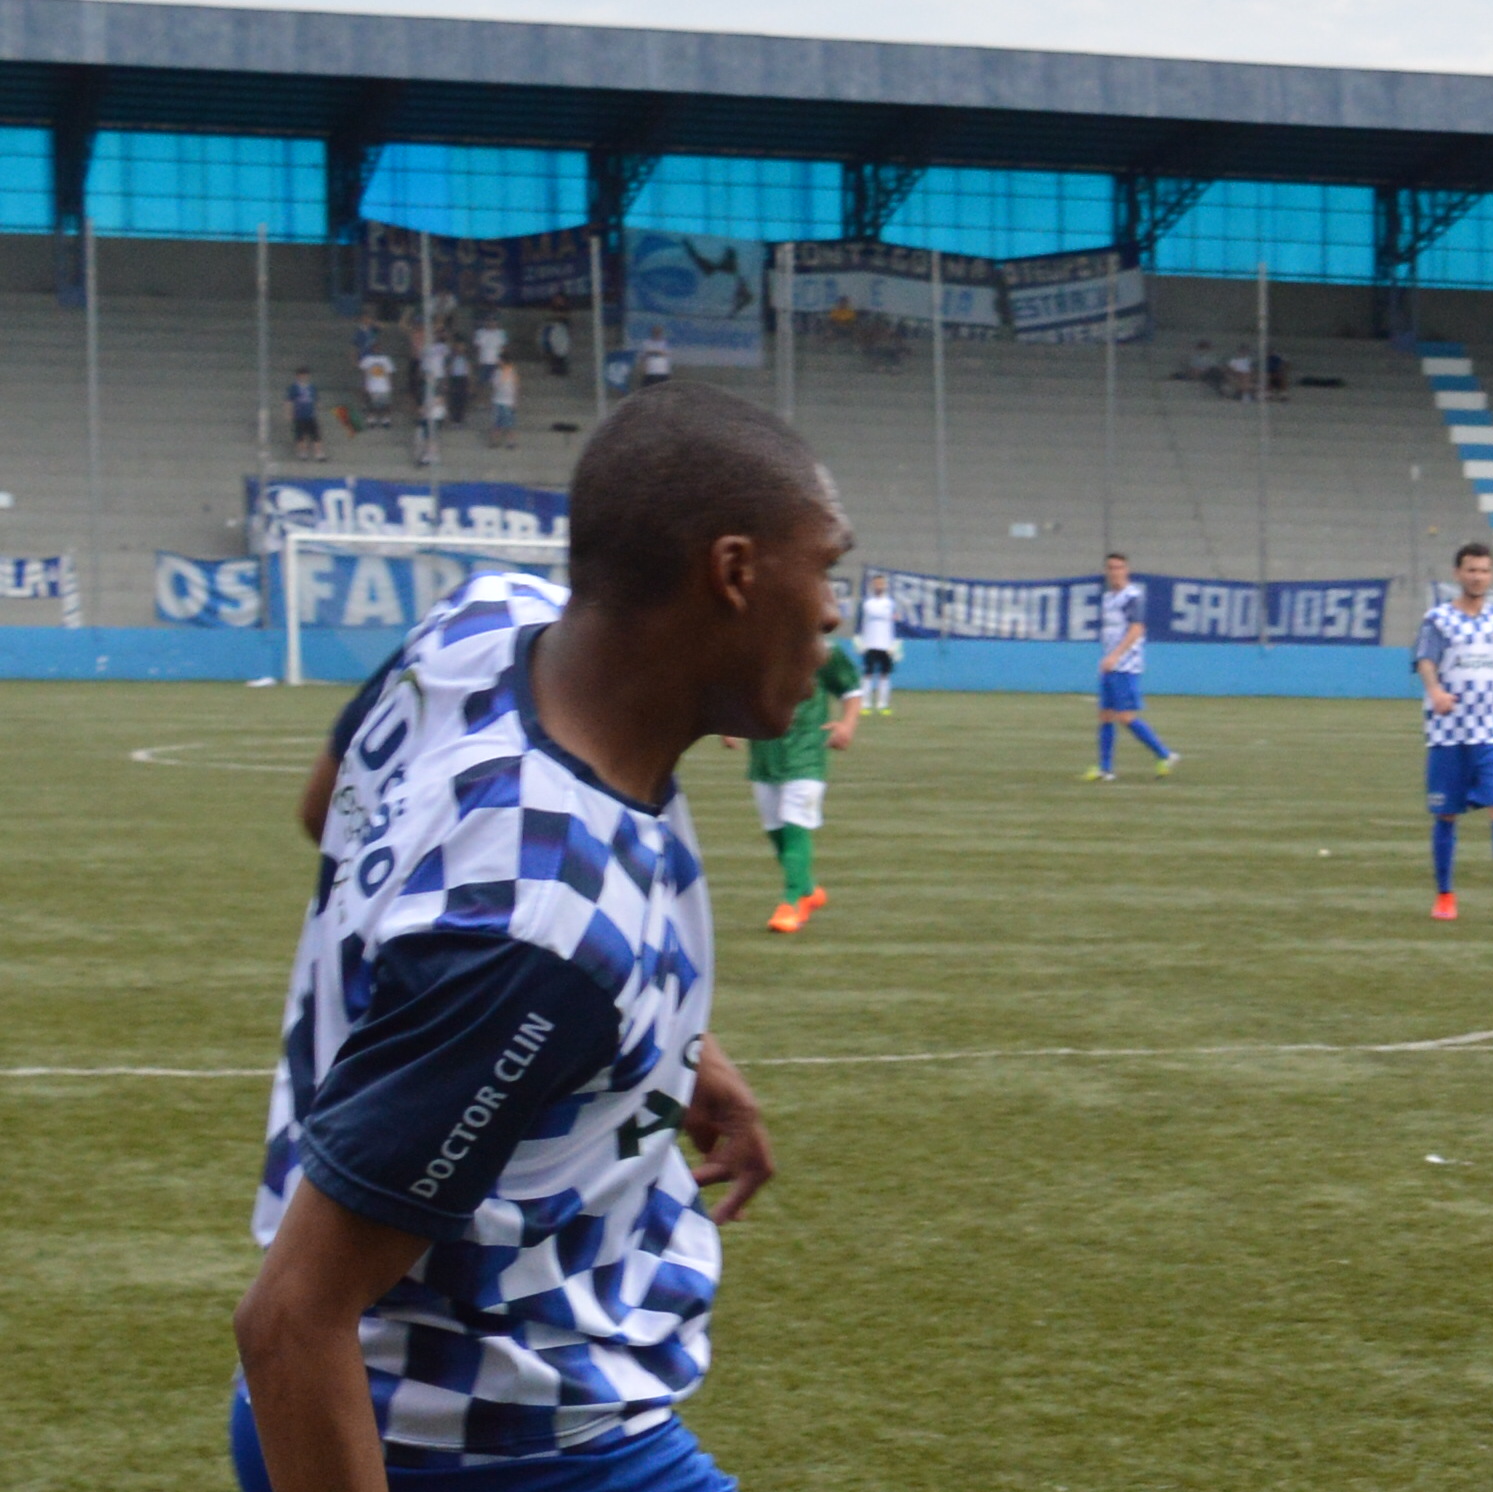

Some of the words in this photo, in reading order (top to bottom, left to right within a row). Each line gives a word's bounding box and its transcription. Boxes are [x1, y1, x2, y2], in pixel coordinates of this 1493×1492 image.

[157, 561, 260, 627] OS
[1264, 587, 1383, 639] JOSE
[409, 1085, 508, 1199] DOCTOR
[493, 1011, 556, 1083] CLIN
